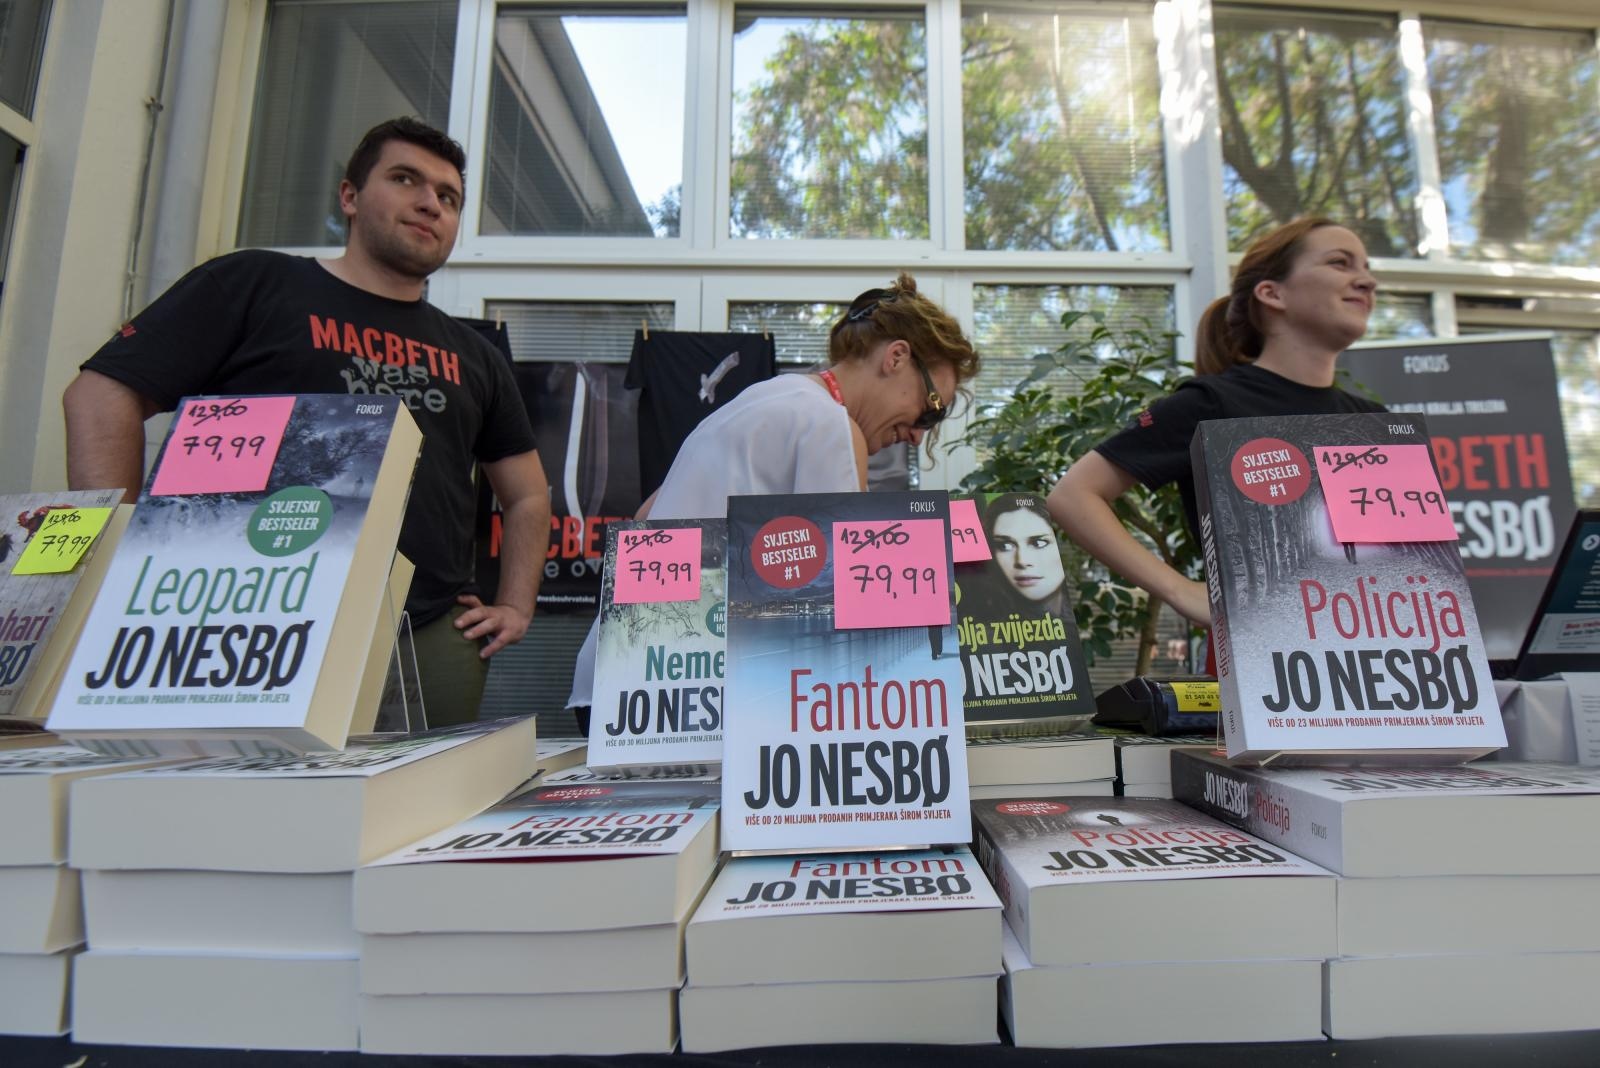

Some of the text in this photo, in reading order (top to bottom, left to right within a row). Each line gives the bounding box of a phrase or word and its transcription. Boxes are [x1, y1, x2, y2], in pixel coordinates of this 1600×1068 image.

[309, 314, 461, 385] MACBETH
[352, 355, 429, 385] was
[1404, 355, 1449, 373] FOKUS
[356, 404, 384, 415] FOKUS
[1388, 424, 1415, 435] FOKUS
[183, 435, 265, 461] 79,99
[1242, 449, 1291, 468] SVJETSKI
[1243, 465, 1301, 485] BESTSELER
[1433, 433, 1550, 493] BETH
[1269, 483, 1287, 497] #1
[268, 500, 320, 514] SVJETSKI
[910, 501, 936, 513] FOKUS
[1015, 498, 1035, 507] FOKUS
[1349, 487, 1446, 518] 79,99
[258, 518, 319, 531] BESTSELER
[1447, 495, 1555, 562] ESBØ
[41, 534, 91, 557] 79,99
[273, 535, 292, 548] #1
[763, 529, 811, 548] SVJETSKI
[762, 545, 817, 566] BESTSELER
[629, 560, 692, 586] 79,99
[784, 566, 801, 580] #1
[849, 564, 936, 599] 79,99
[1205, 535, 1222, 605] NESBØ
[125, 552, 320, 627] Leopard
[1300, 576, 1466, 654] Policija
[990, 612, 1066, 650] zvijezda
[85, 619, 316, 692] JO NESBØ
[645, 645, 724, 681] Neme
[969, 646, 1074, 697] NESBØ
[1262, 644, 1479, 714] JO NESBØ
[259, 693, 290, 703] SVIJETA
[790, 664, 949, 733] Fantom
[1057, 693, 1078, 702] SVIJETA
[606, 686, 723, 737] JO NES
[1268, 714, 1485, 728] VIŠE OD 23 MILIJUNA PRODANIH PRIMJERAKA ŠIROM SVIJETA
[606, 737, 617, 747] VIŠE
[618, 738, 626, 747] OD
[627, 738, 635, 746] 30
[635, 737, 660, 745] MILIJUNA
[661, 736, 688, 744] PRODANIH
[744, 735, 950, 810] JO NESBØ
[1204, 771, 1249, 819] JO NESBØ
[507, 811, 694, 831] Fantom
[745, 809, 951, 826] VIŠE OD 20 MILIJUNA PRODANIH PRIMJERAKA ŠIROM SVIJETA
[1256, 790, 1290, 836] Policija
[416, 831, 503, 852] JO
[495, 825, 681, 848] NESBØ
[1070, 828, 1251, 848] Policija
[1311, 822, 1327, 840] FOKUS
[789, 857, 965, 878] Fantom
[1042, 844, 1287, 871] JO NESBØ
[726, 880, 797, 905] JO
[805, 874, 972, 900] NESBØ
